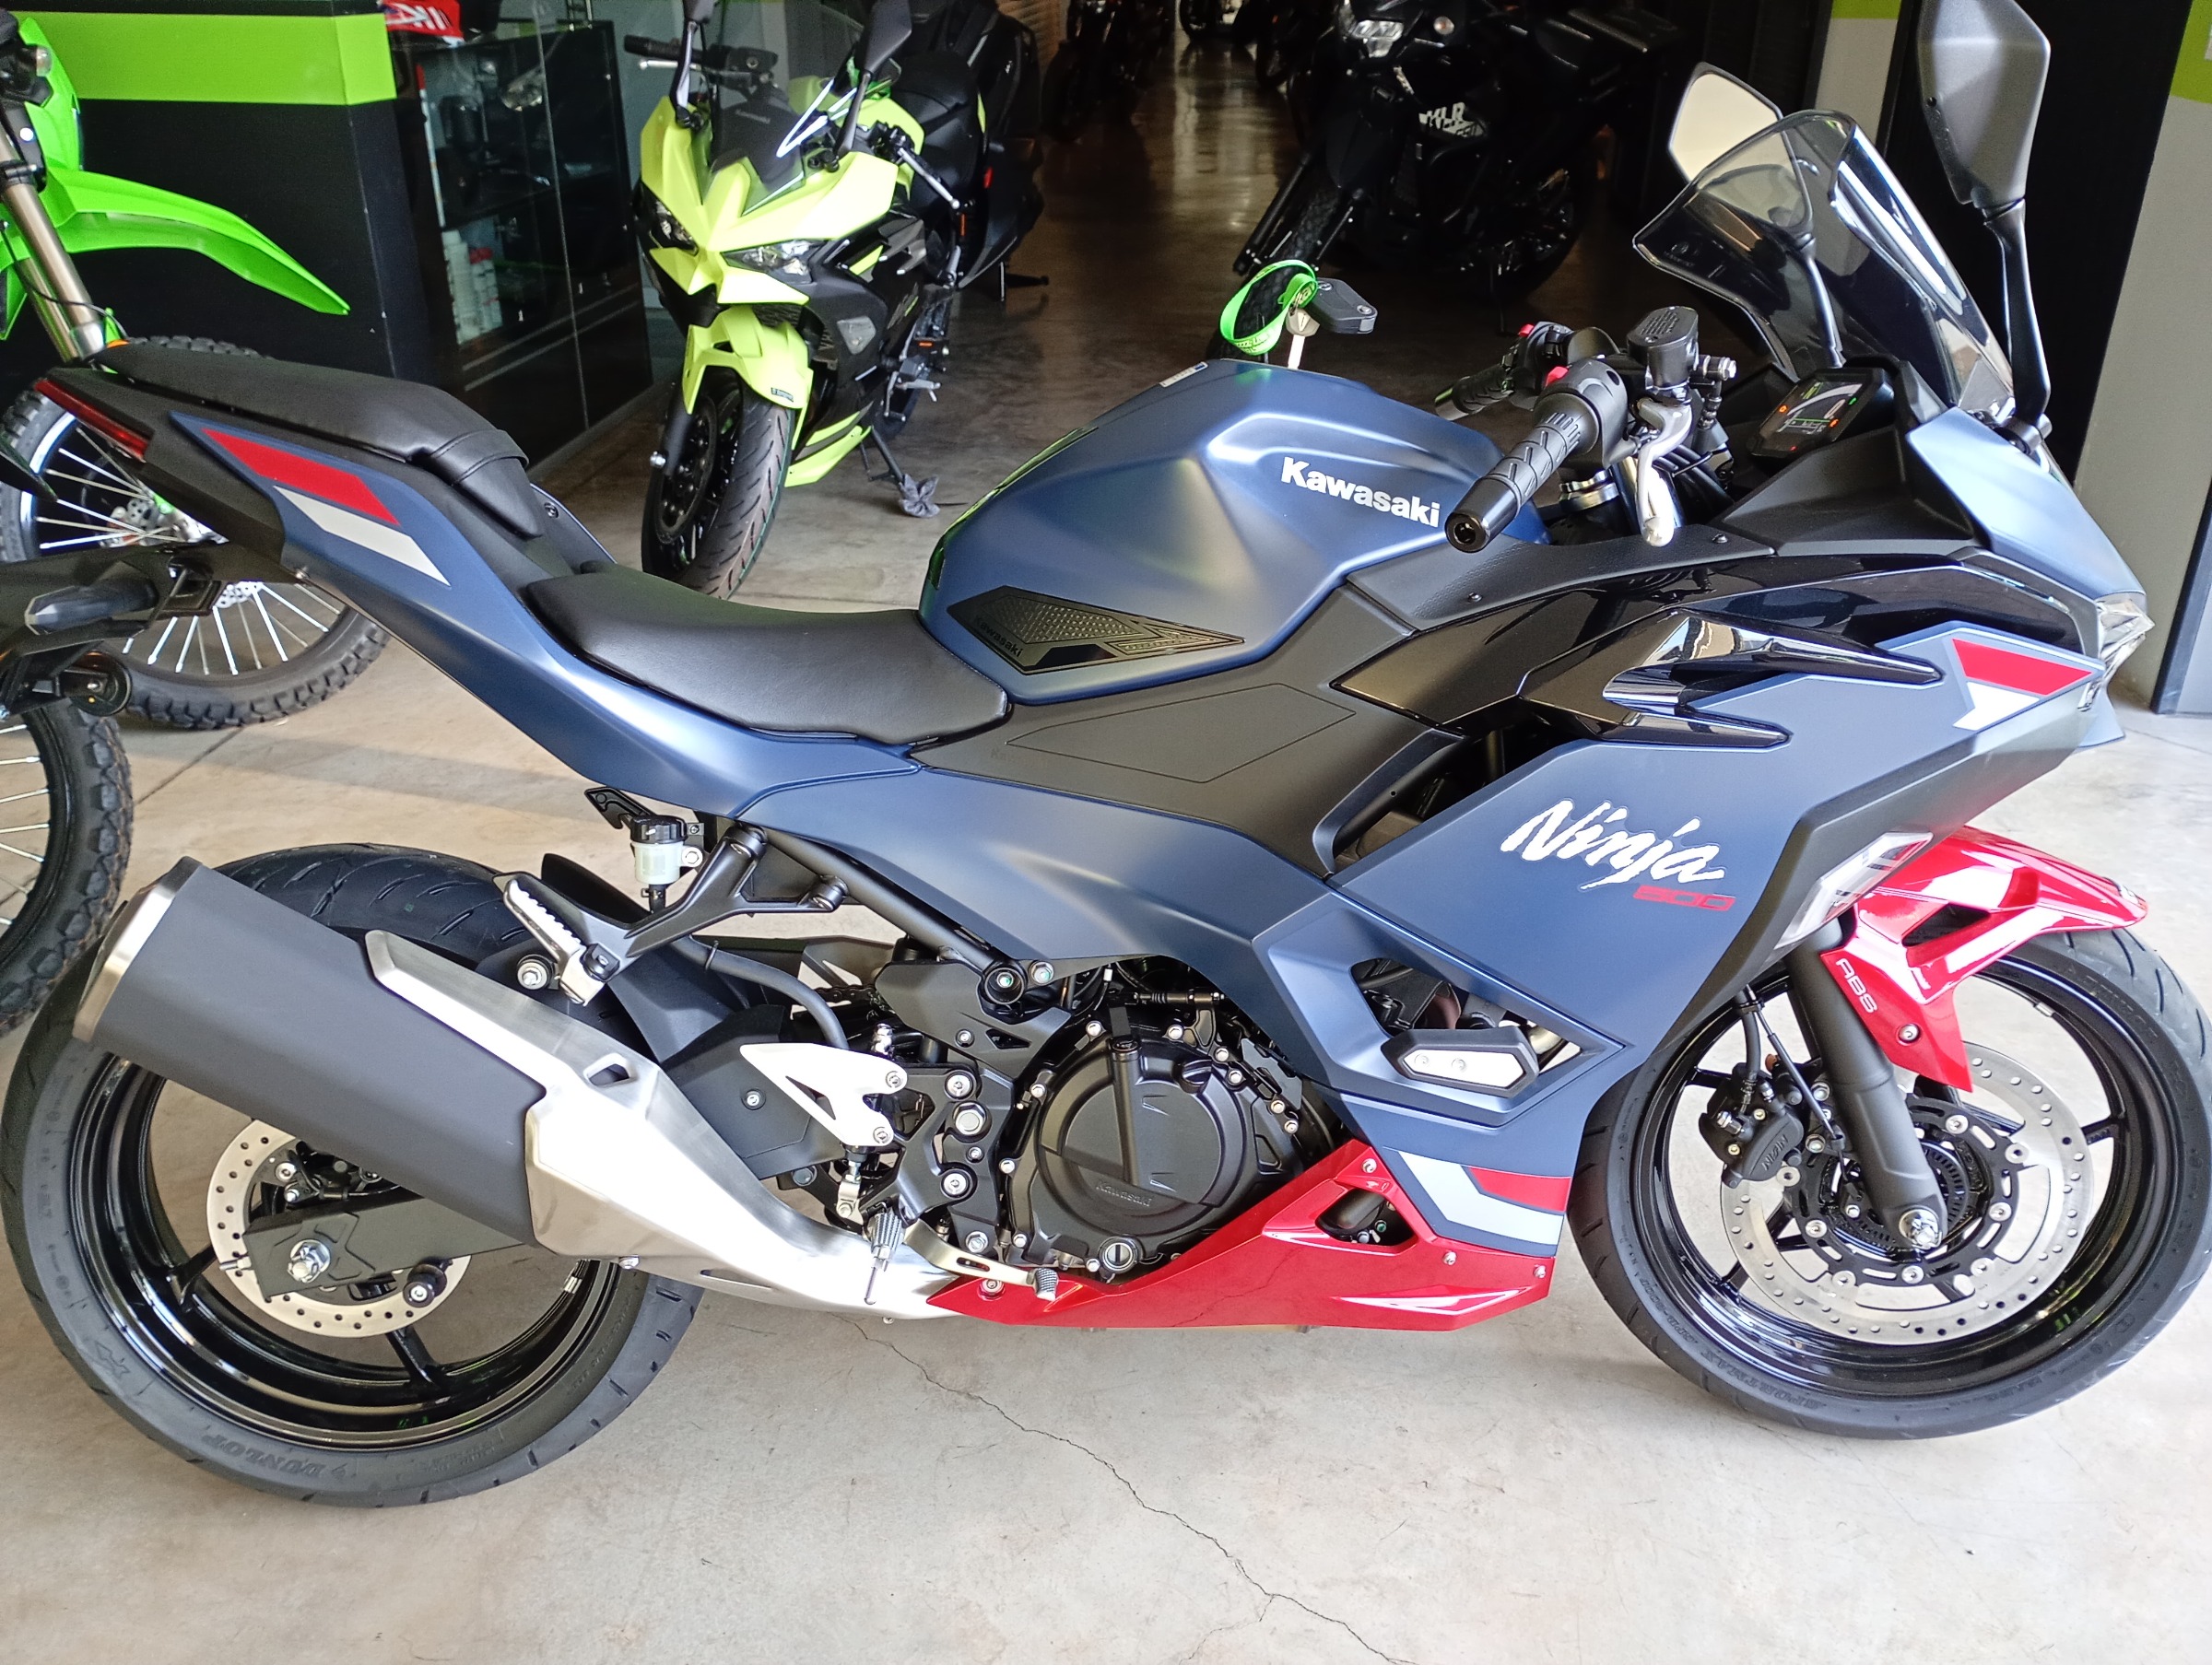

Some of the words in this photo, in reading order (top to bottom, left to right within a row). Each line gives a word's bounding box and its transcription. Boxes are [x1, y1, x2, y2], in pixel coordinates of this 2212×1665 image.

[1281, 457, 1441, 528] Kawasaki
[975, 614, 1024, 658] Kawasaki
[1500, 800, 1726, 891] Ninja
[1835, 957, 1878, 1014] ABS
[201, 1434, 326, 1478] DUNLOP
